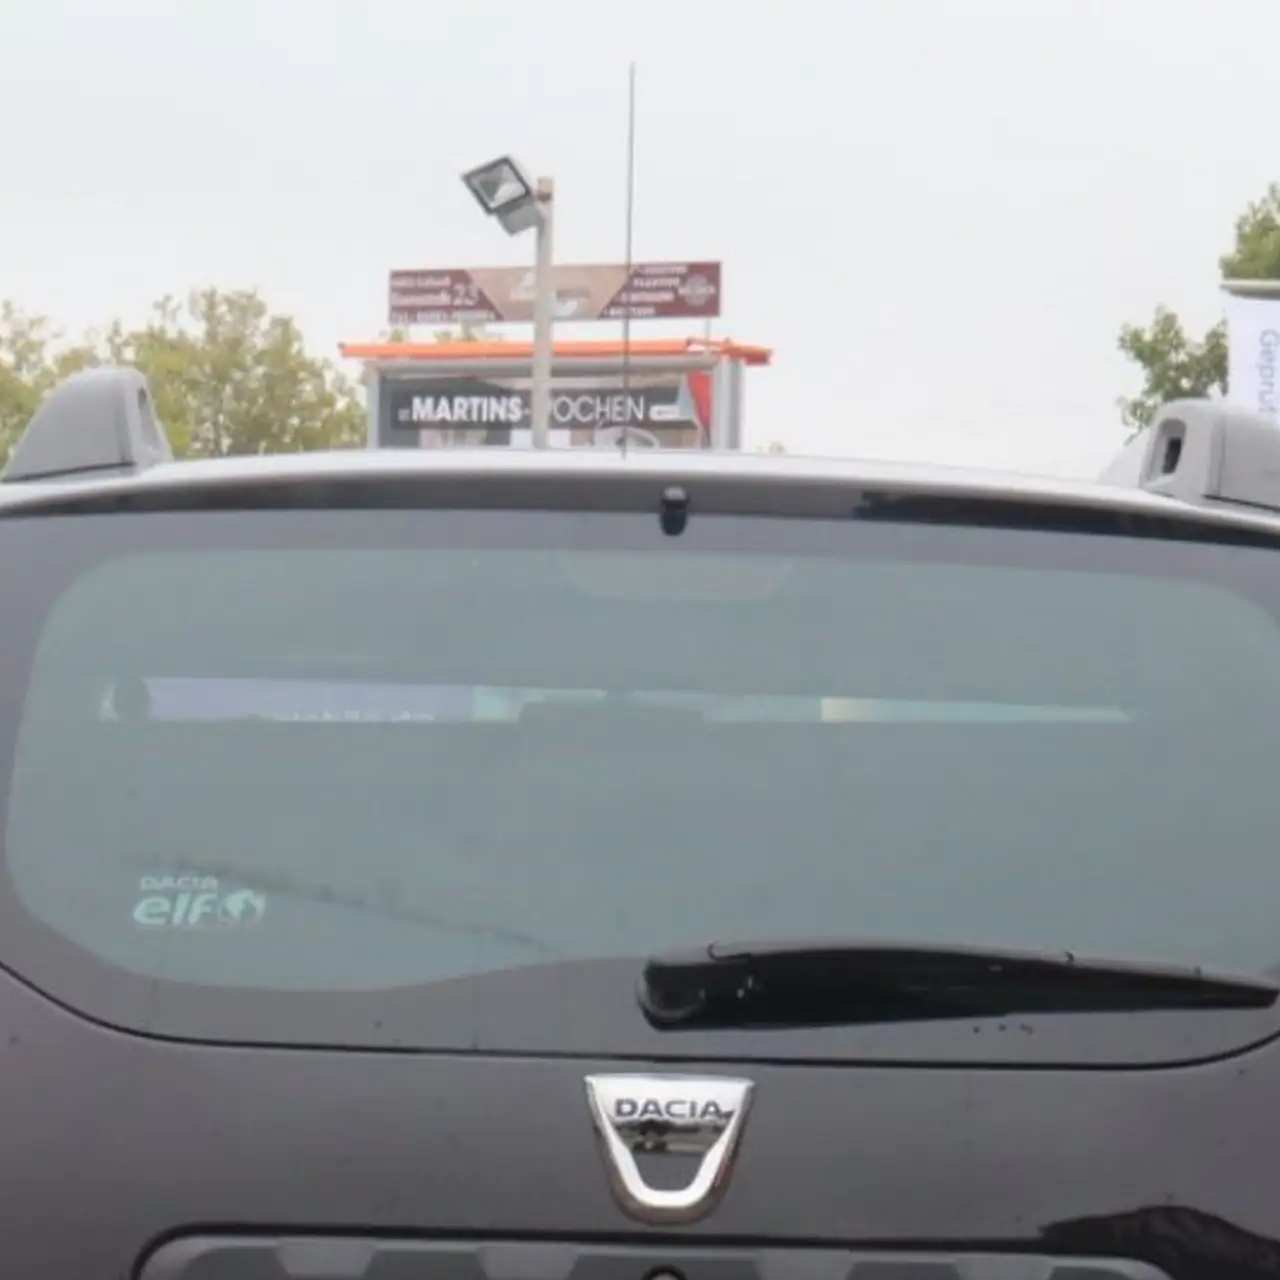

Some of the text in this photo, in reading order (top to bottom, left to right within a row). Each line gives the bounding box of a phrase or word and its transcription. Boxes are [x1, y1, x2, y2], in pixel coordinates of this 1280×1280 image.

[412, 395, 645, 424] MARTINS-OCHEN
[133, 893, 218, 926] elf
[614, 1098, 723, 1119] DACIA
